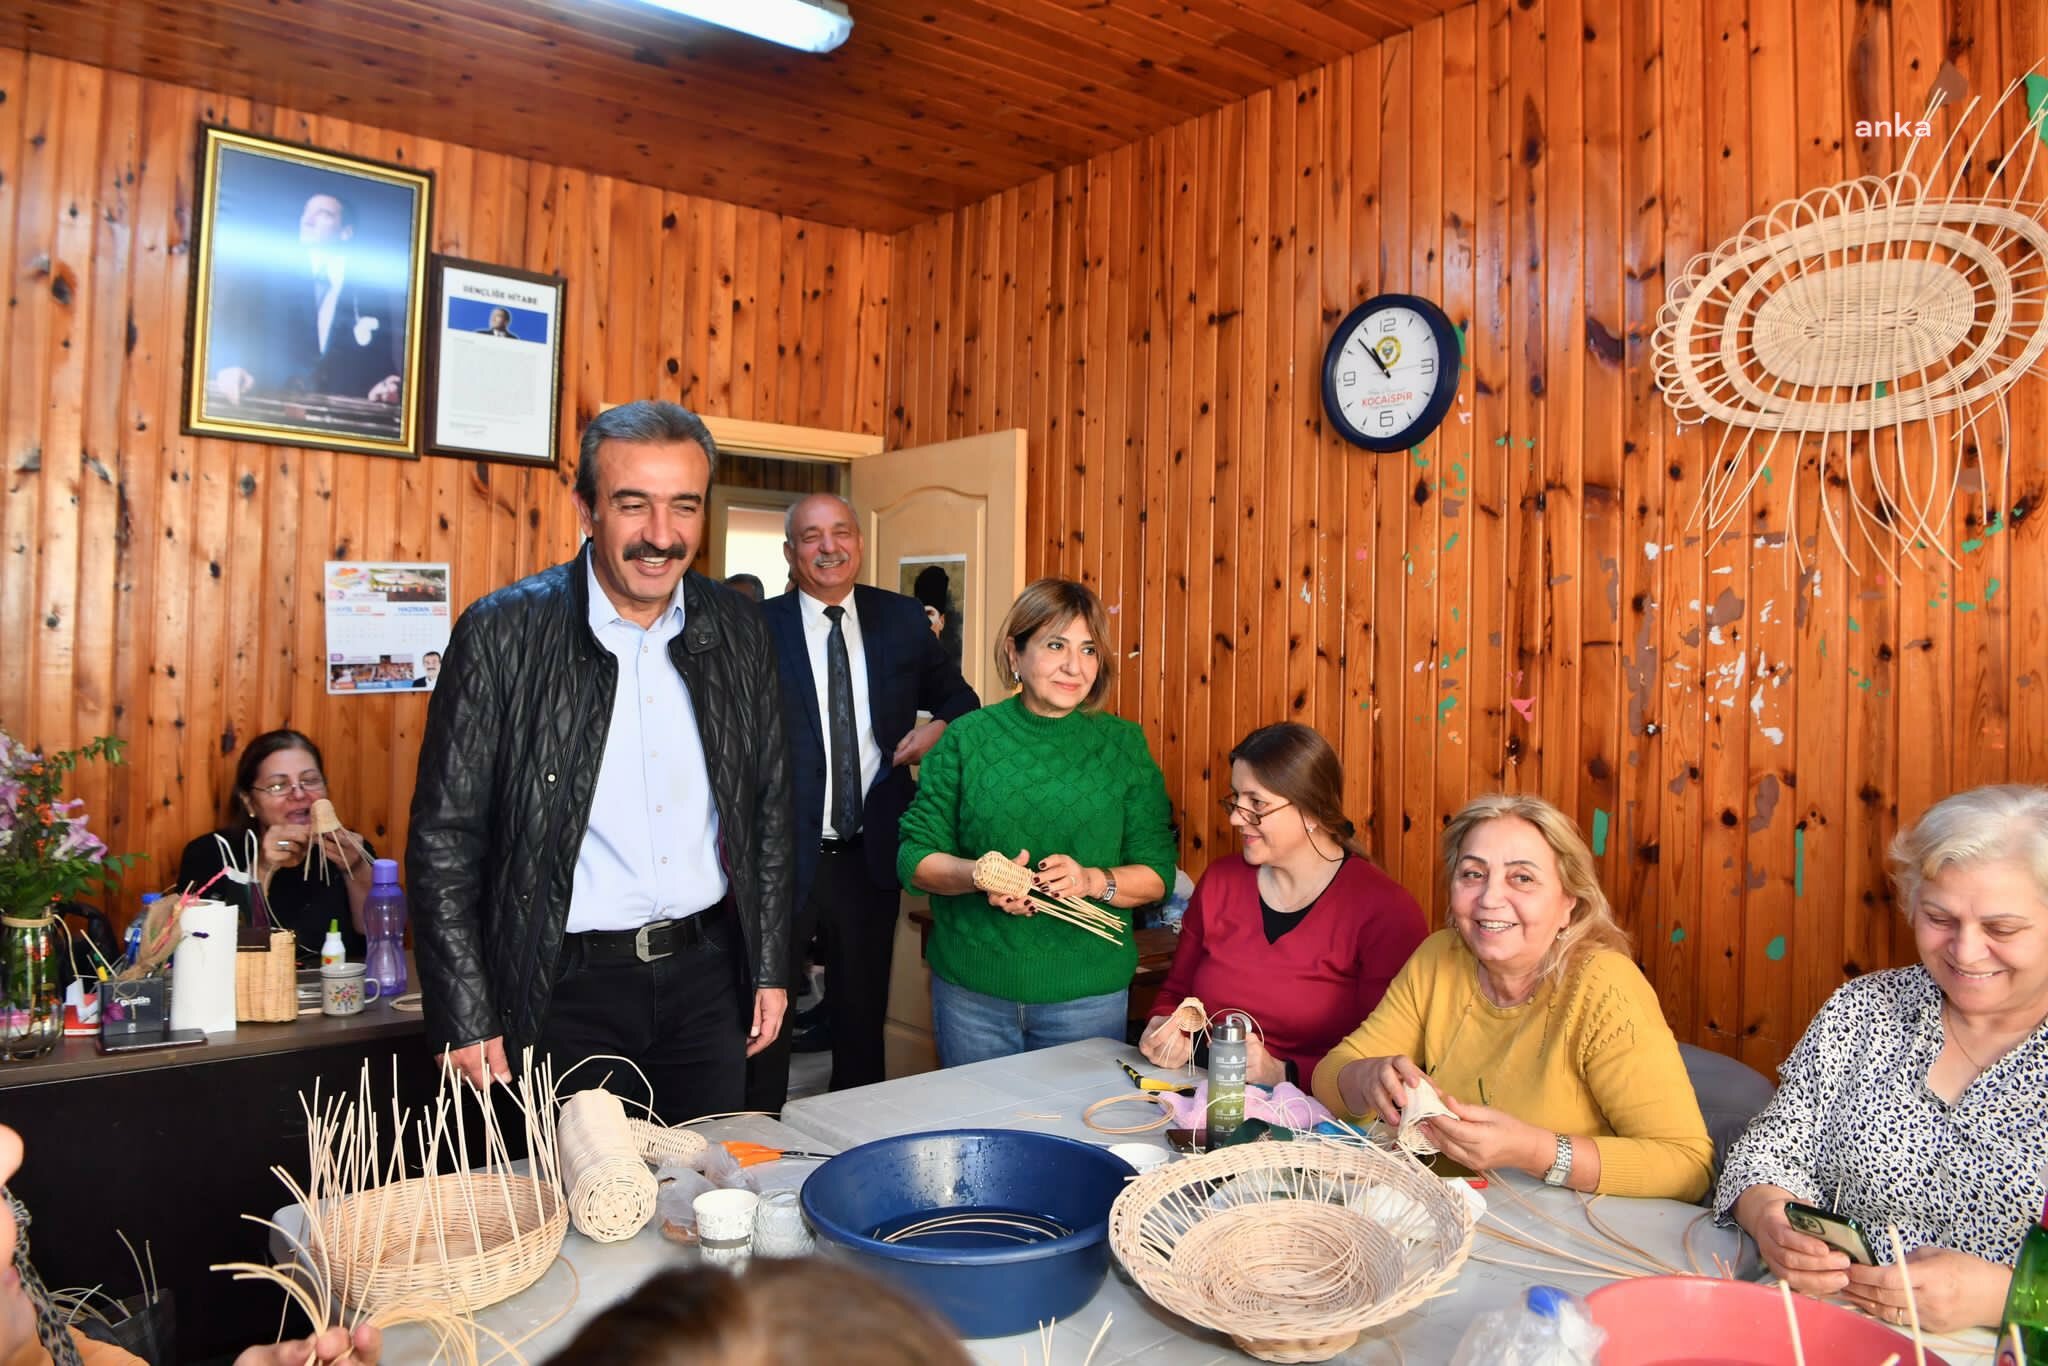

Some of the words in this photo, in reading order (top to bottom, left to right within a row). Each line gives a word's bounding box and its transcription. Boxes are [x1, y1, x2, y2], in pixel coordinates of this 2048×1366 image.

[508, 292, 538, 305] HİTABE
[1379, 318, 1396, 333] 12
[1421, 358, 1434, 375] 3
[1343, 371, 1356, 387] 9
[1379, 410, 1394, 428] 6
